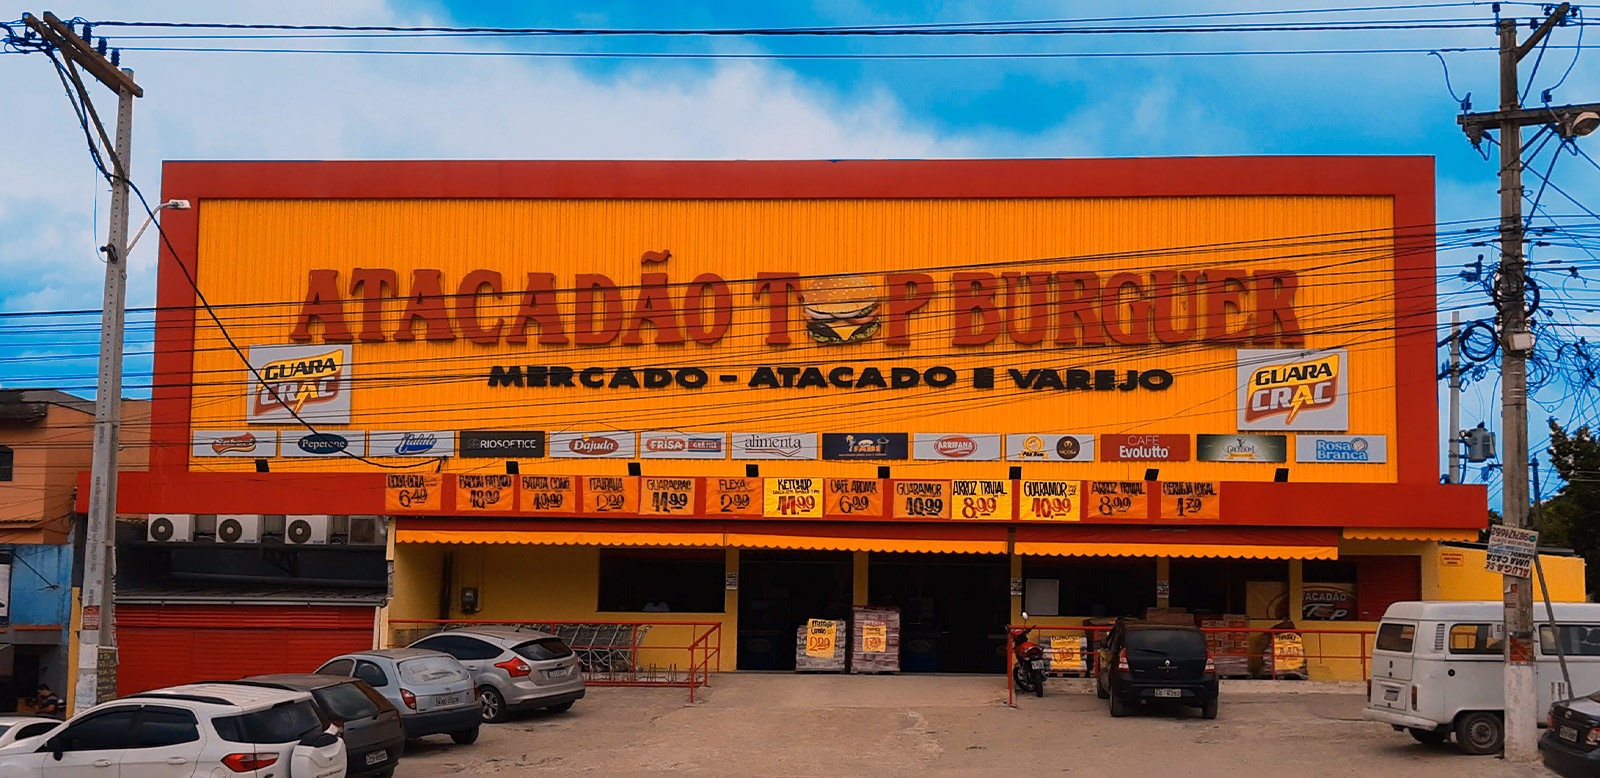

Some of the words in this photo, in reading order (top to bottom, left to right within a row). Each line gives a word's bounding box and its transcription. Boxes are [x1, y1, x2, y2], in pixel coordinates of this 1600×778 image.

[290, 249, 733, 346] ATACADÃO
[952, 269, 1305, 347] BURGUER
[265, 357, 337, 380] GUARA
[1255, 362, 1333, 386] GUARA
[488, 365, 709, 389] MERCADO
[748, 366, 958, 389] ATACADO
[973, 367, 994, 389] E
[1008, 368, 1174, 391] VAREJO
[1251, 381, 1333, 415] CRAC
[573, 440, 614, 453] Dajuda
[650, 440, 684, 450] FRISA
[745, 434, 801, 449] alimenta
[938, 441, 973, 450] ARRIFANA
[1316, 439, 1351, 450] Rosa
[1119, 446, 1169, 458] Evolutto
[1316, 449, 1368, 460] Branca
[777, 479, 812, 490] KETCHUP
[896, 482, 942, 496] GUARAMOR
[952, 480, 978, 496] ARROZ
[1023, 480, 1067, 498] GUARAMOR
[1486, 553, 1509, 563] CASA
[1510, 557, 1530, 568] UMA
